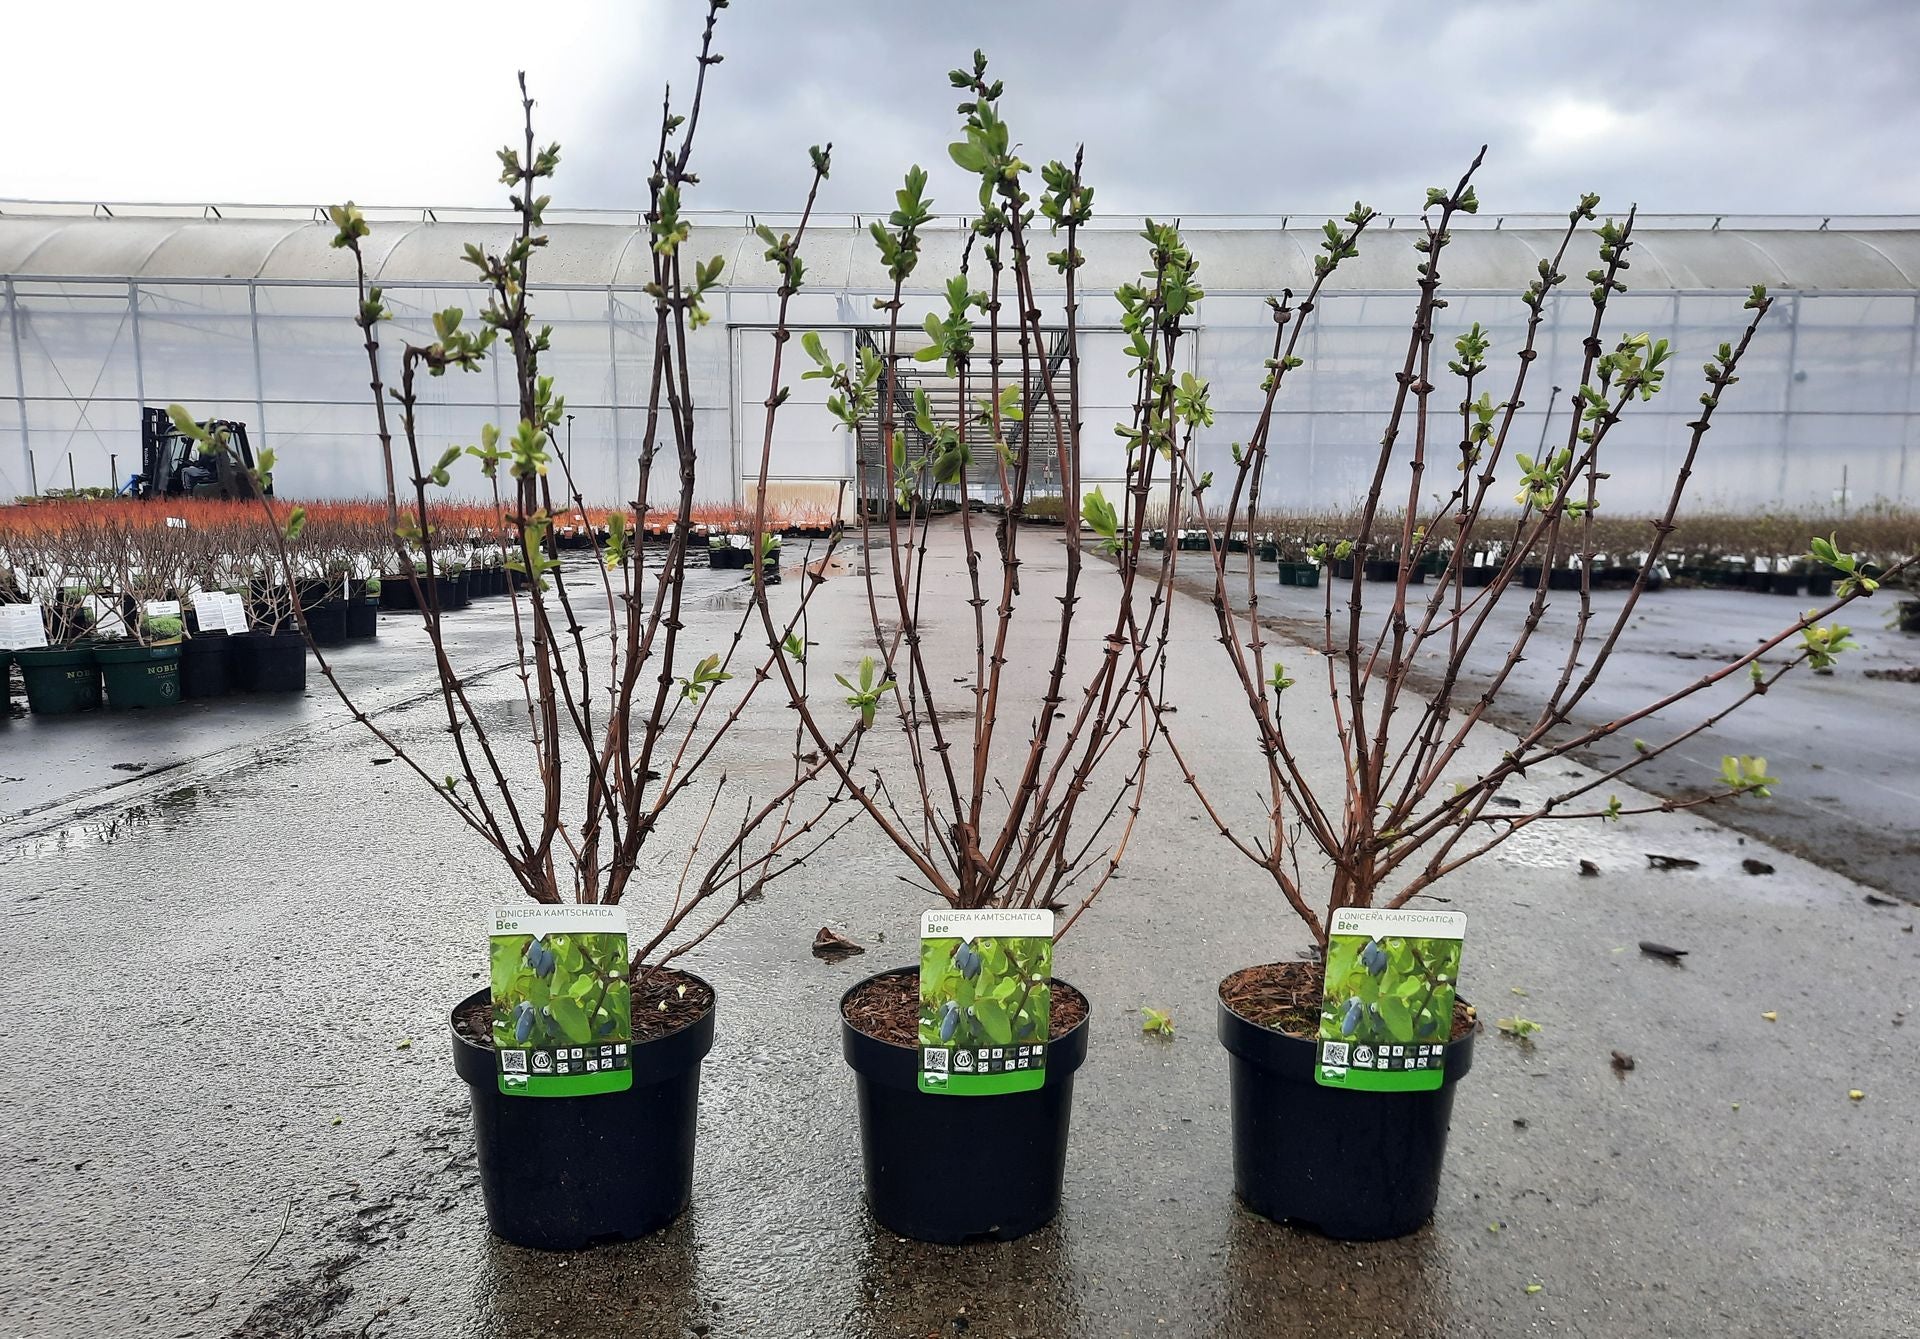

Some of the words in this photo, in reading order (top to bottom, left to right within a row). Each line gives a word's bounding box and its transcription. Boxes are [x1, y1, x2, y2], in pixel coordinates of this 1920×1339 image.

[495, 909, 541, 919] LONICERA
[544, 908, 614, 917] KAMTSCHATICA
[927, 913, 972, 922] LONICERA
[974, 913, 1042, 921] KAMTSCHATICA
[1339, 912, 1383, 921] LONICERA
[1385, 913, 1454, 924] KAMTSCHATICA
[496, 920, 518, 930] Bee
[928, 923, 949, 933] Bee
[1338, 921, 1359, 931] Bee
